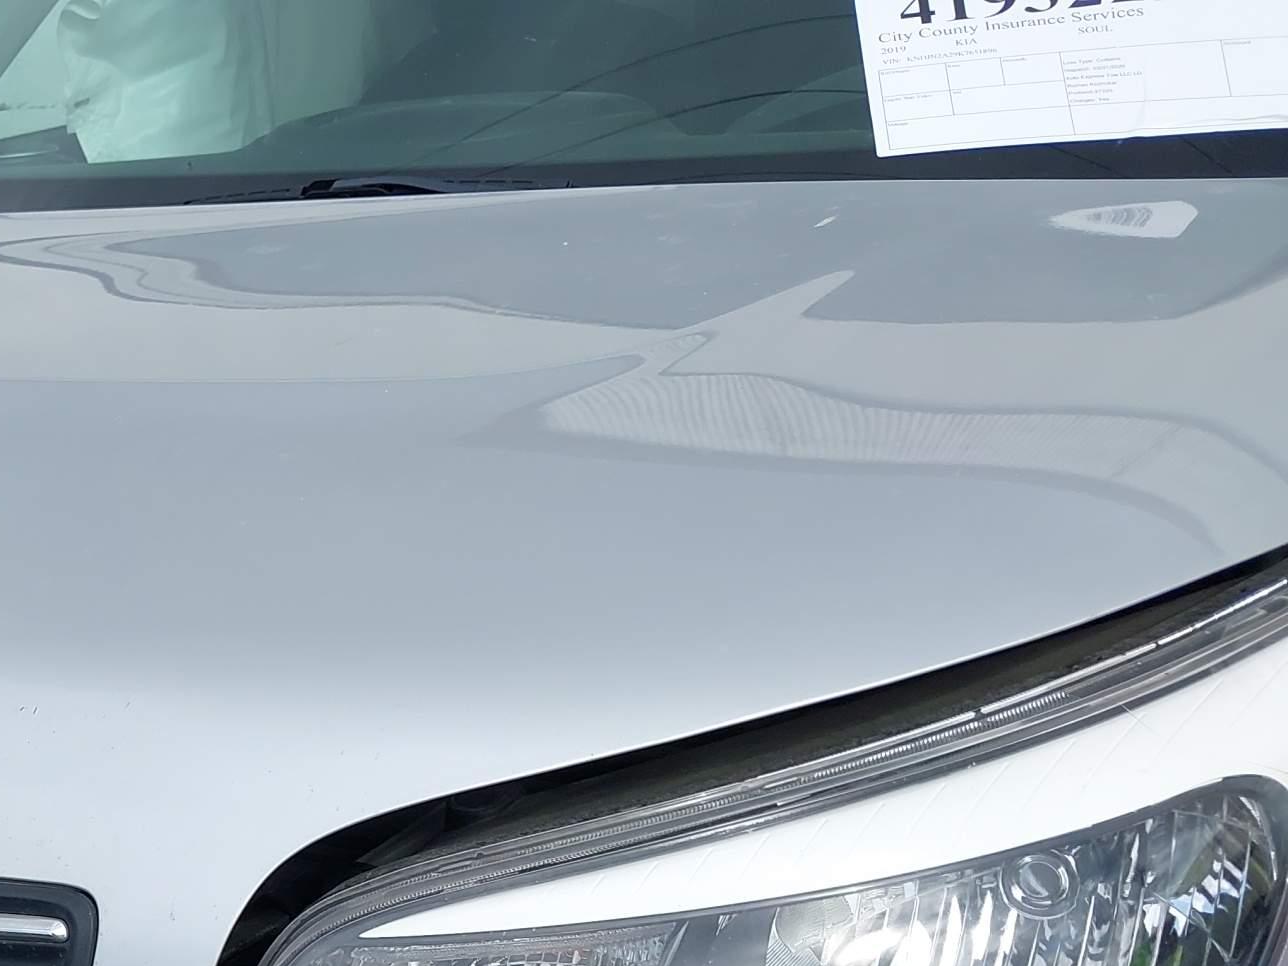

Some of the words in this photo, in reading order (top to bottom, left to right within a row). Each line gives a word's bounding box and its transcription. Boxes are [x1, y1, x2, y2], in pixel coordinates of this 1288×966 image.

[878, 31, 913, 43] City
[919, 24, 979, 38] County
[985, 15, 1065, 31] Insurance
[1071, 7, 1145, 23] Services
[880, 46, 907, 55] 2019
[955, 38, 978, 47] KIA
[1078, 25, 1113, 34] SOUL
